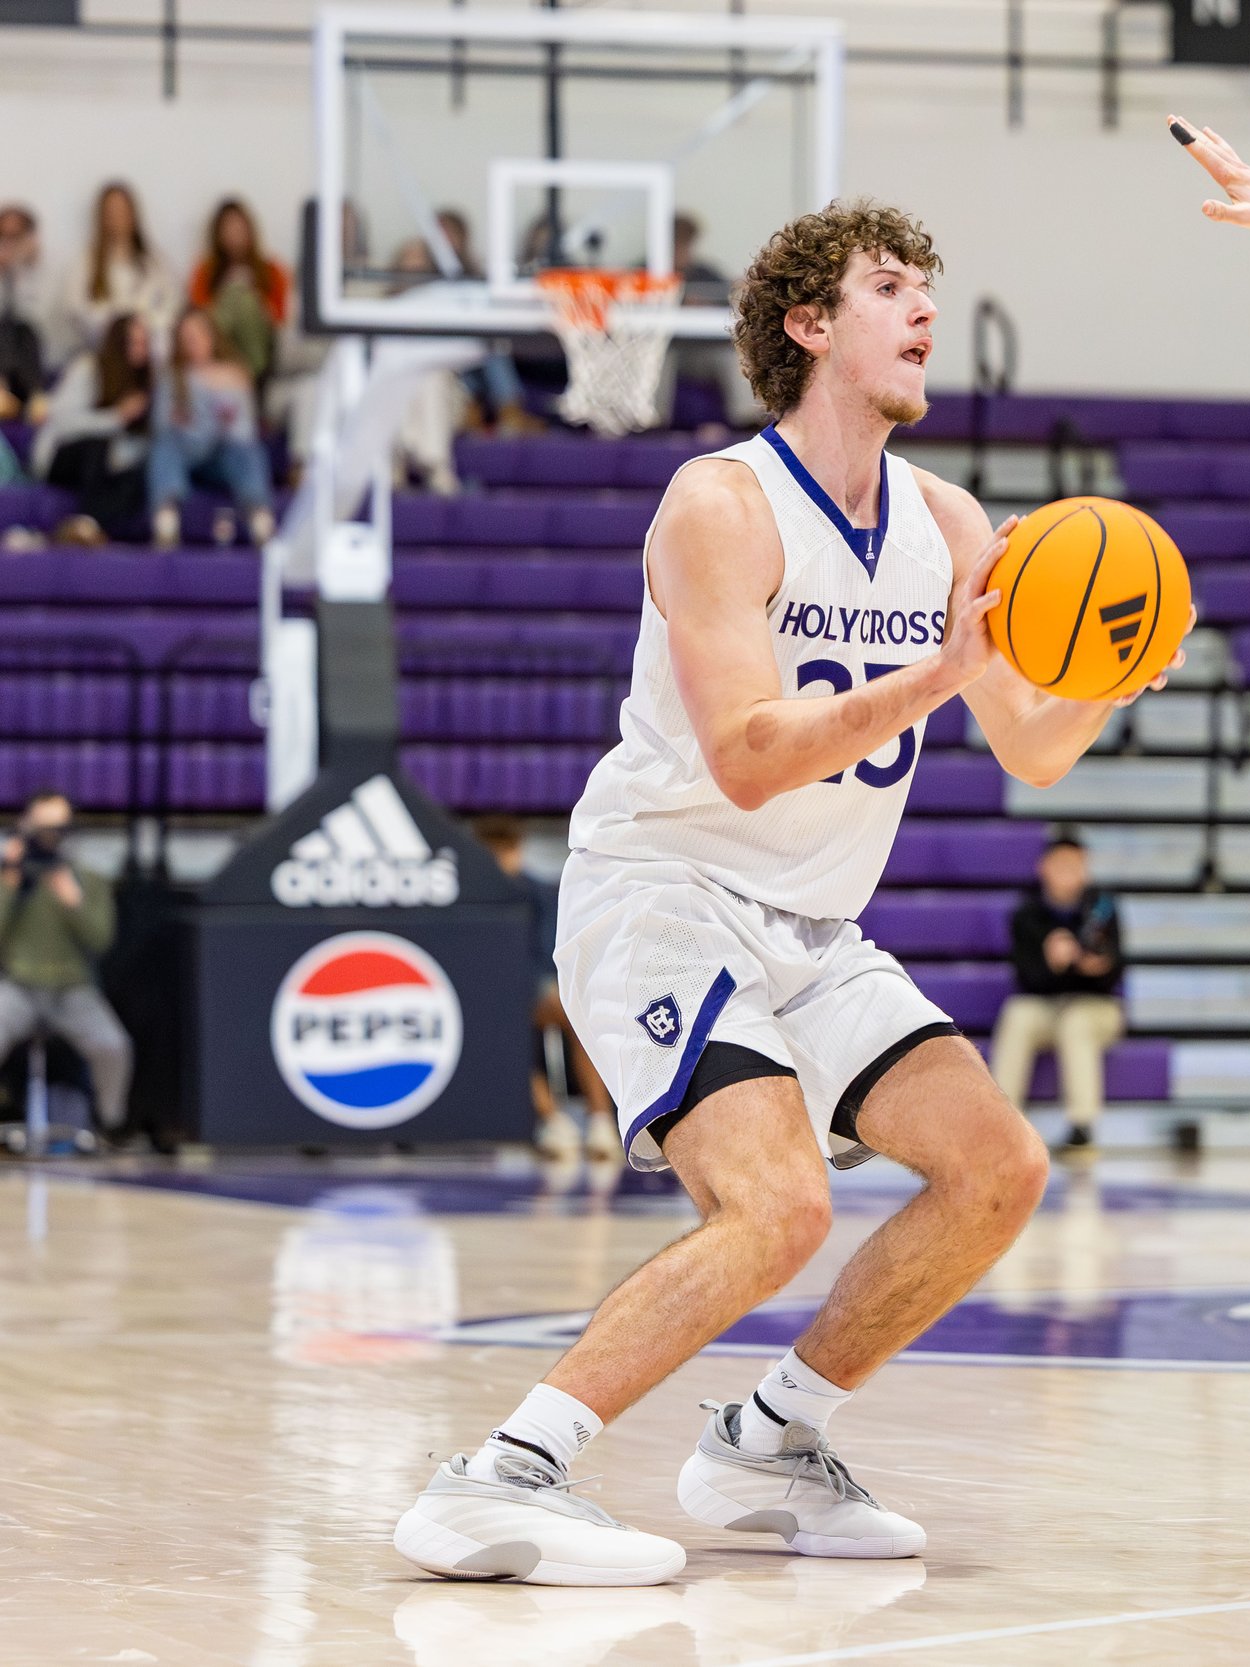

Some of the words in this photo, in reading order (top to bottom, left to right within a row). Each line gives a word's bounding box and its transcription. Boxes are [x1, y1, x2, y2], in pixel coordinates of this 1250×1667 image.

[778, 601, 861, 643] HOLY
[860, 608, 946, 645] CROSS
[270, 853, 460, 908] adidas
[291, 1009, 444, 1044] PEPSI
